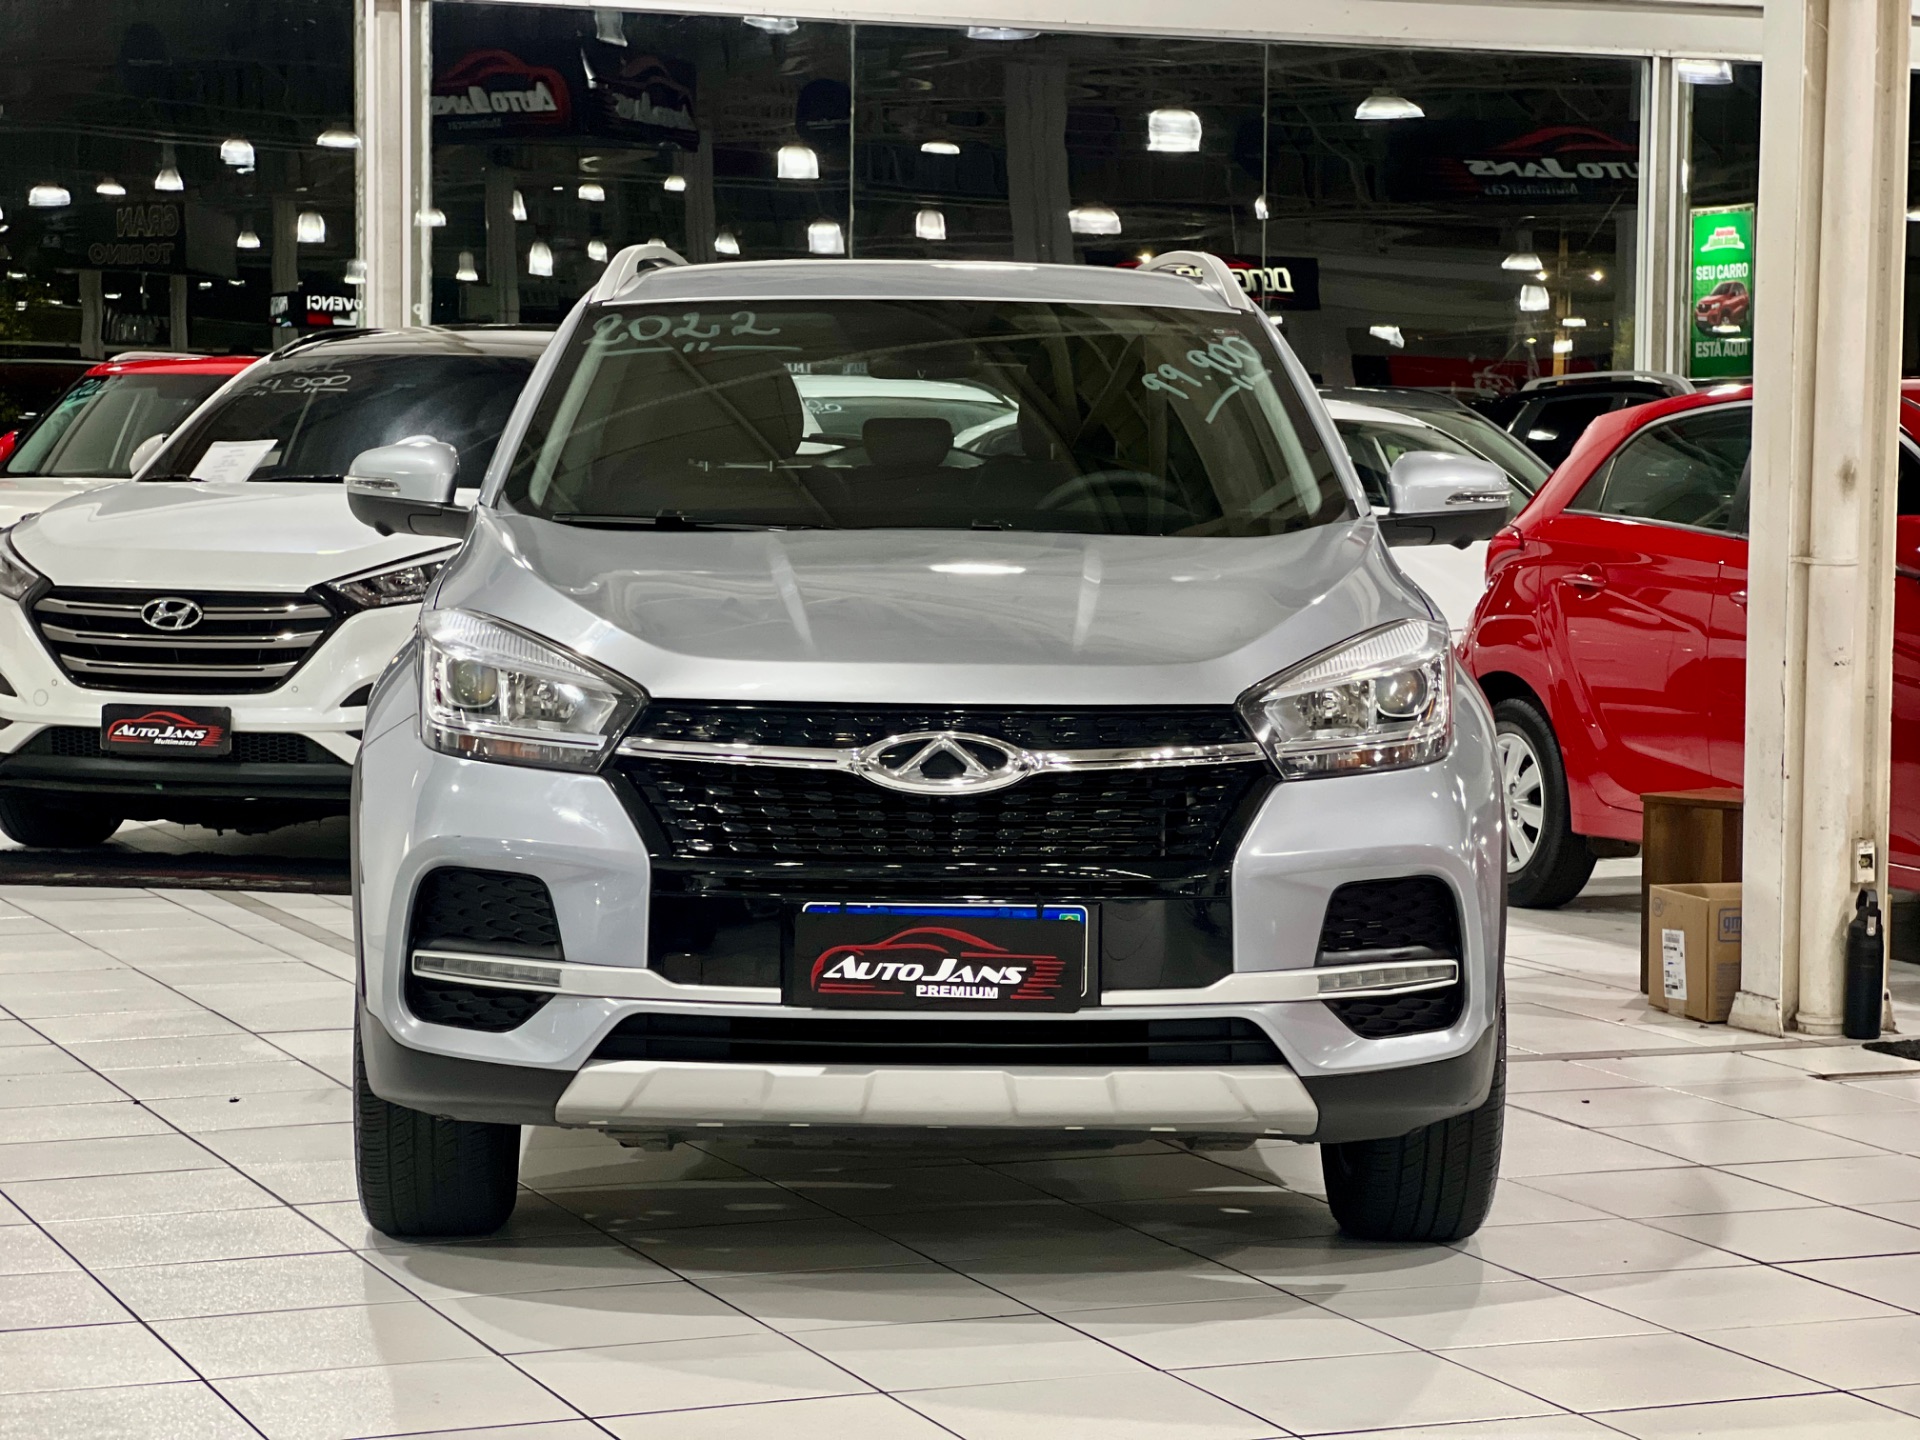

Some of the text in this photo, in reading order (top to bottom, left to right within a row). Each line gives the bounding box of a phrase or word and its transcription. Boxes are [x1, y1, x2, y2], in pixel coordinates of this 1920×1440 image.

[1695, 262, 1749, 281] SEU CARRO
[583, 311, 781, 345] 2022
[1722, 341, 1748, 357] AQUI
[153, 737, 197, 747] Multimarcas
[1722, 916, 1743, 934] gm
[822, 955, 1028, 985] AUTO JANS
[915, 984, 999, 1000] PREMIUM
